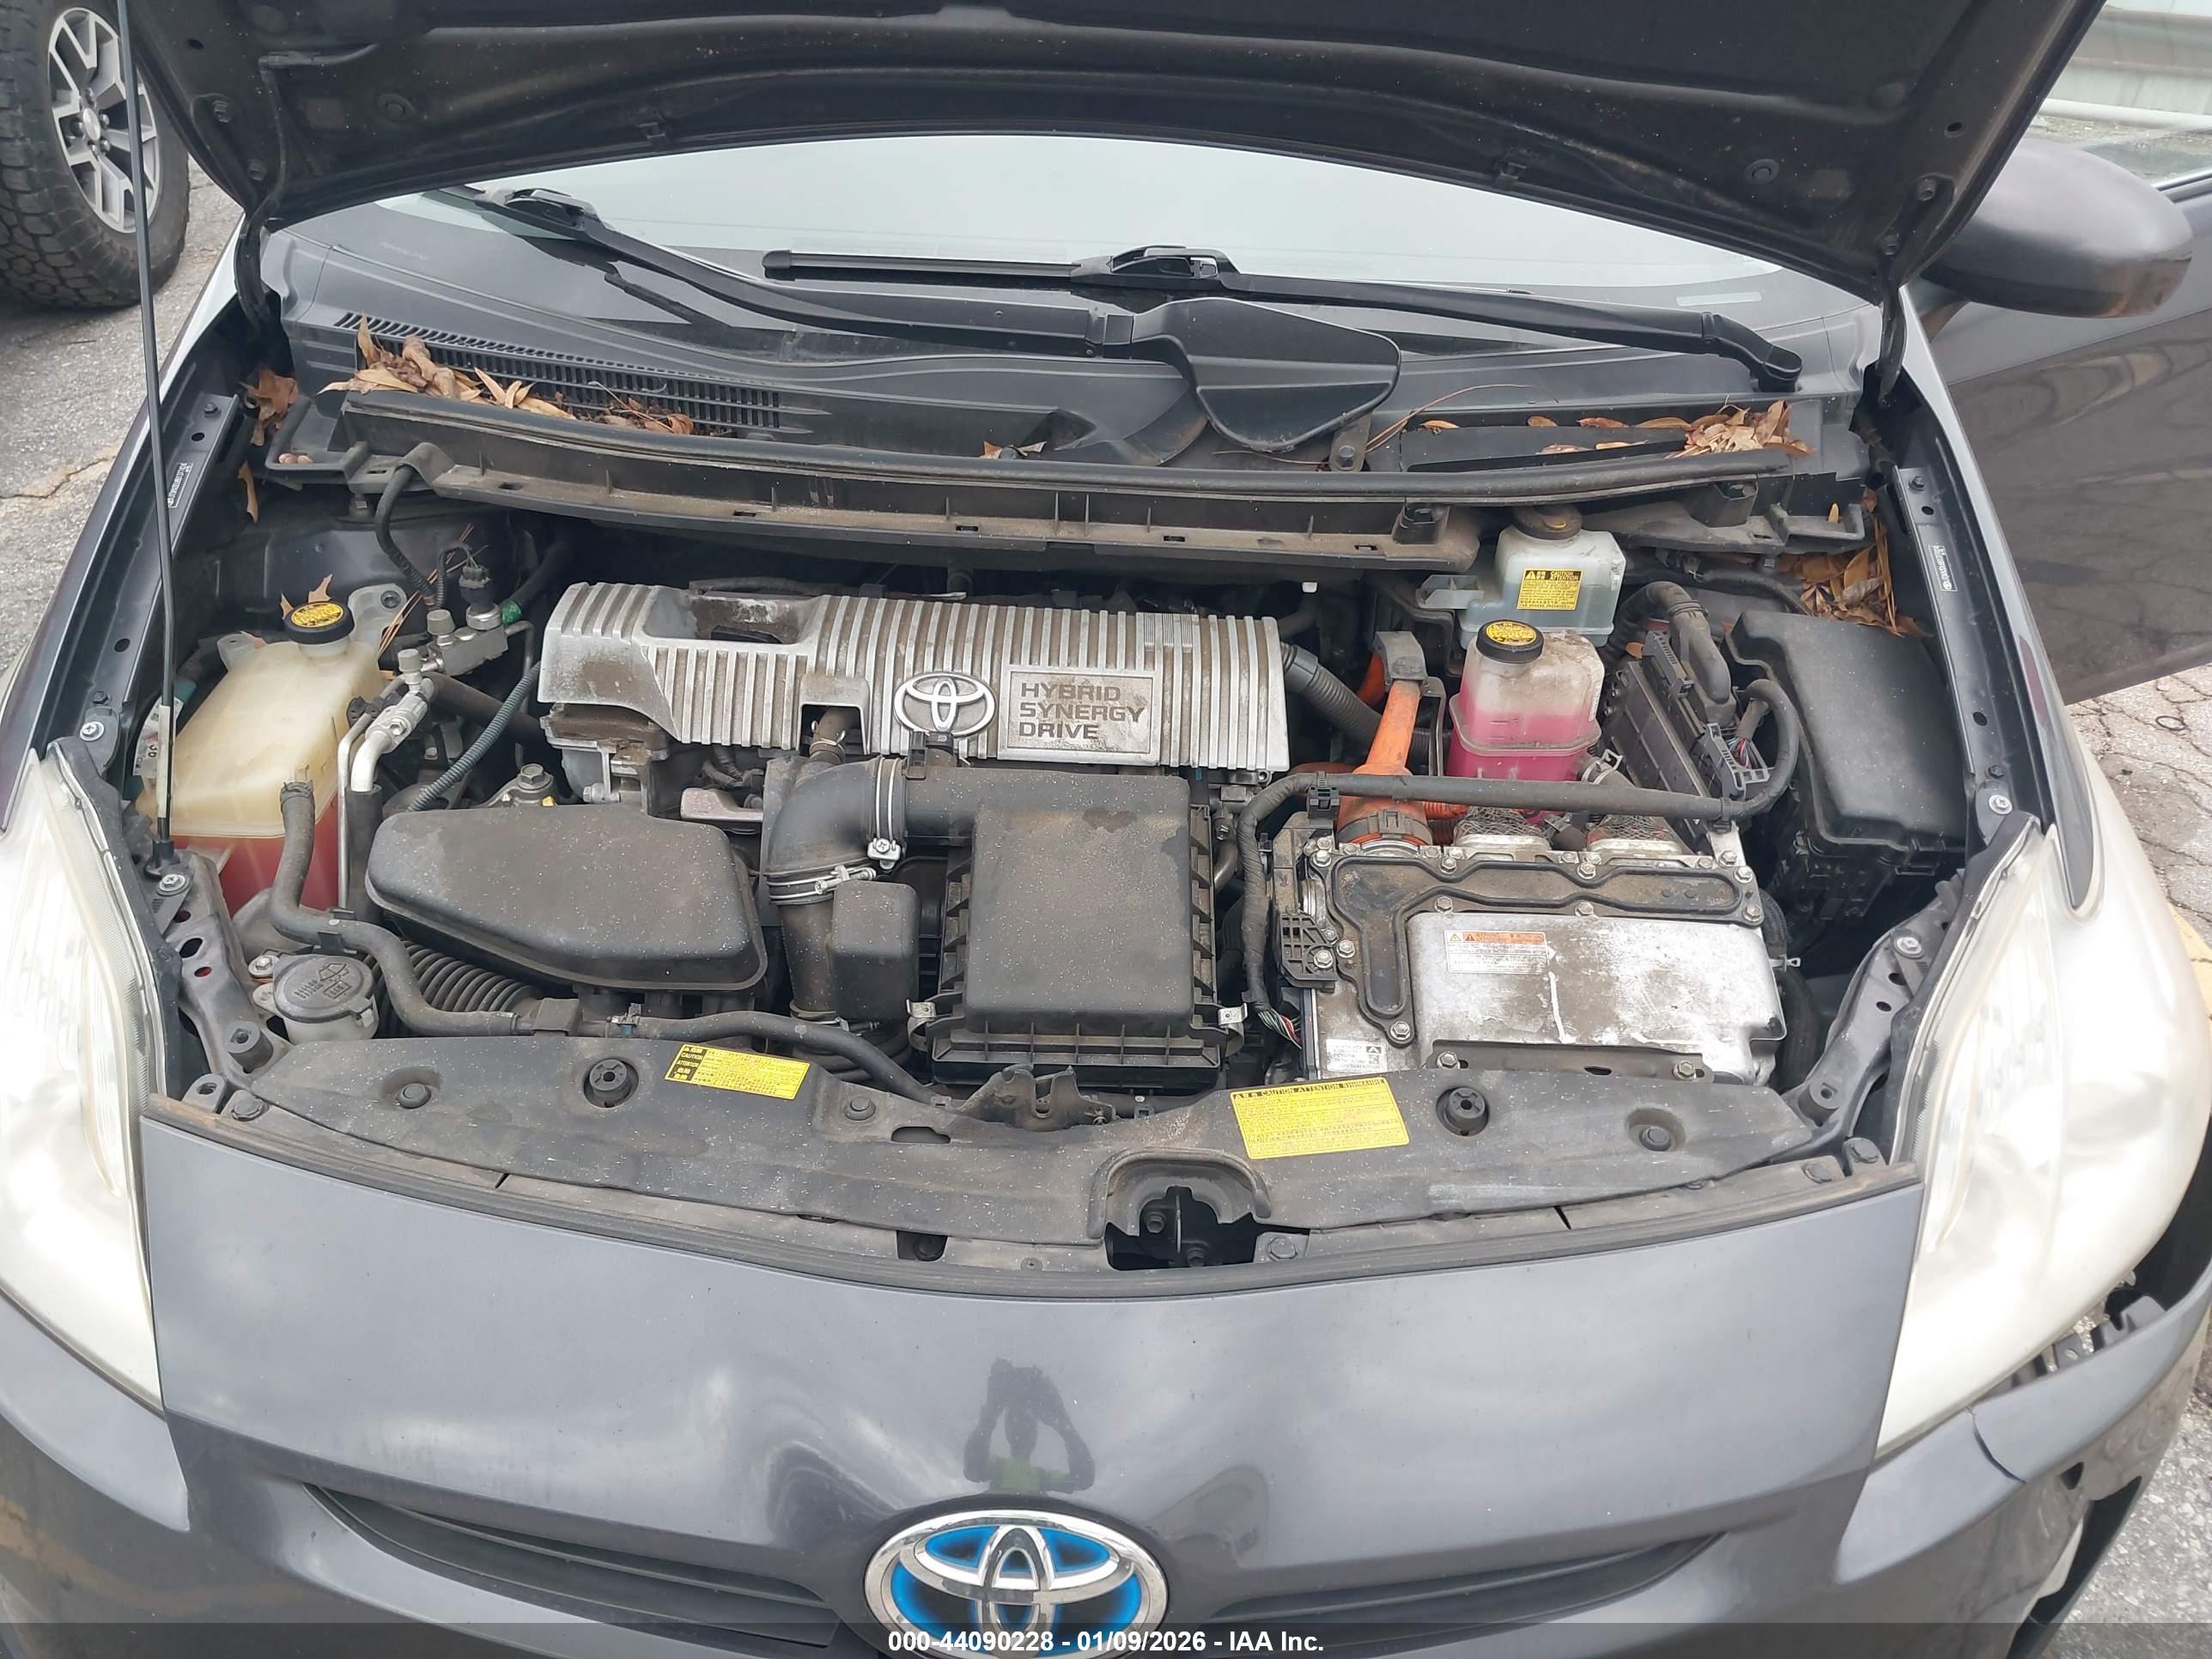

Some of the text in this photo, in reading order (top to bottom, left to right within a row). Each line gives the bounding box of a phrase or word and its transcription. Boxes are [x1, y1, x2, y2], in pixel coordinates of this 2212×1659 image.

[1021, 683, 1121, 702] HYBRID
[1020, 702, 1145, 723] SYNERGY
[1019, 721, 1099, 740] DRIVE
[681, 1052, 704, 1060] CAUTION
[1261, 1087, 1296, 1097] CAUTION
[1299, 1083, 1340, 1093] ATTENTION
